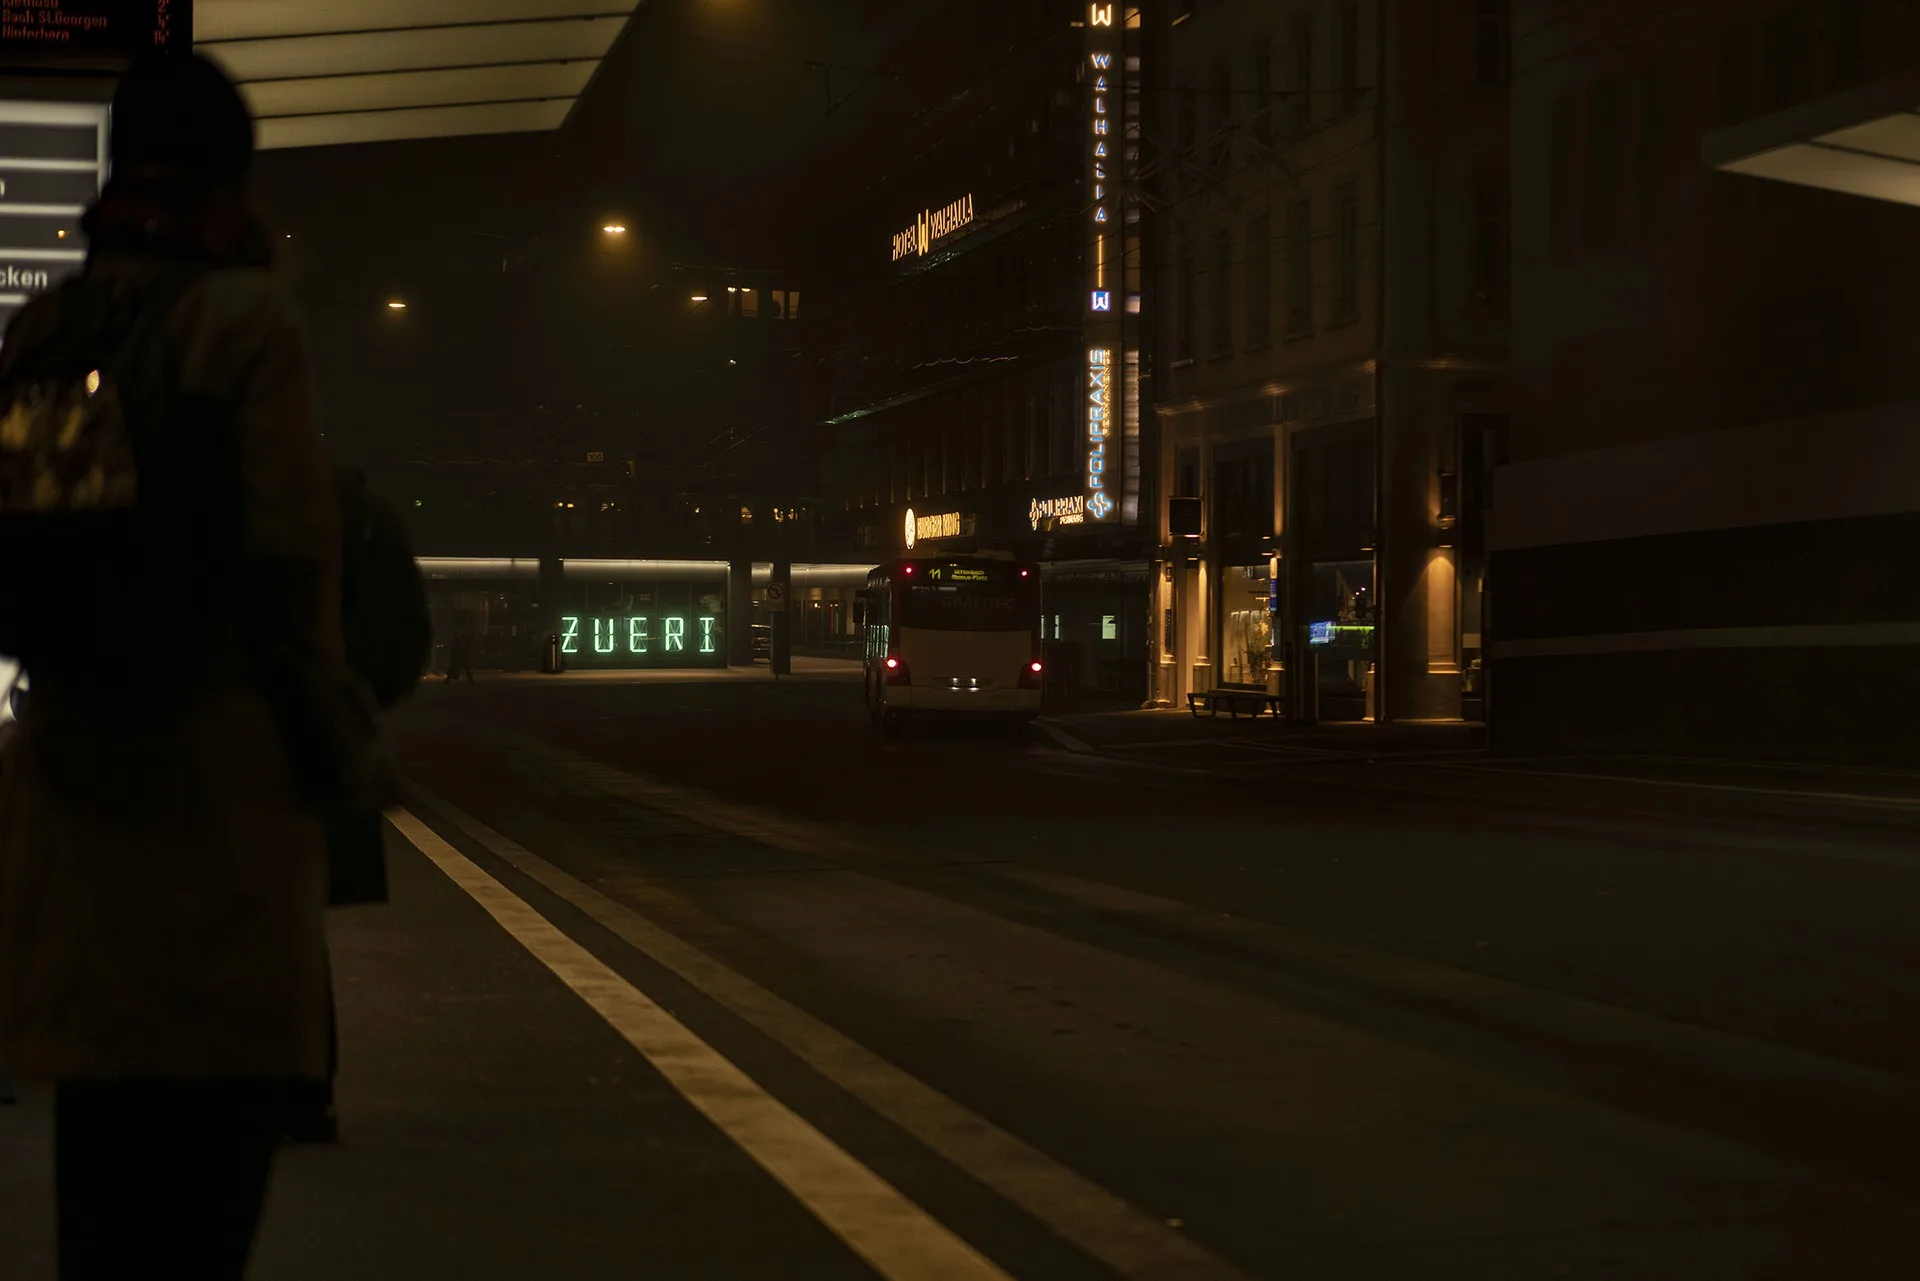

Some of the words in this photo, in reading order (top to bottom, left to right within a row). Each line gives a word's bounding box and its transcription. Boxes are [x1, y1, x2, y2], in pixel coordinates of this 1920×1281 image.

[1090, 52, 1111, 222] WALHALLA
[892, 224, 917, 261] HOTEL
[930, 192, 974, 241] WALHALLA
[1089, 348, 1105, 489] POLIPRAXIS
[942, 512, 960, 537] KING
[929, 568, 941, 580] 11
[561, 616, 715, 653] ZUERI
